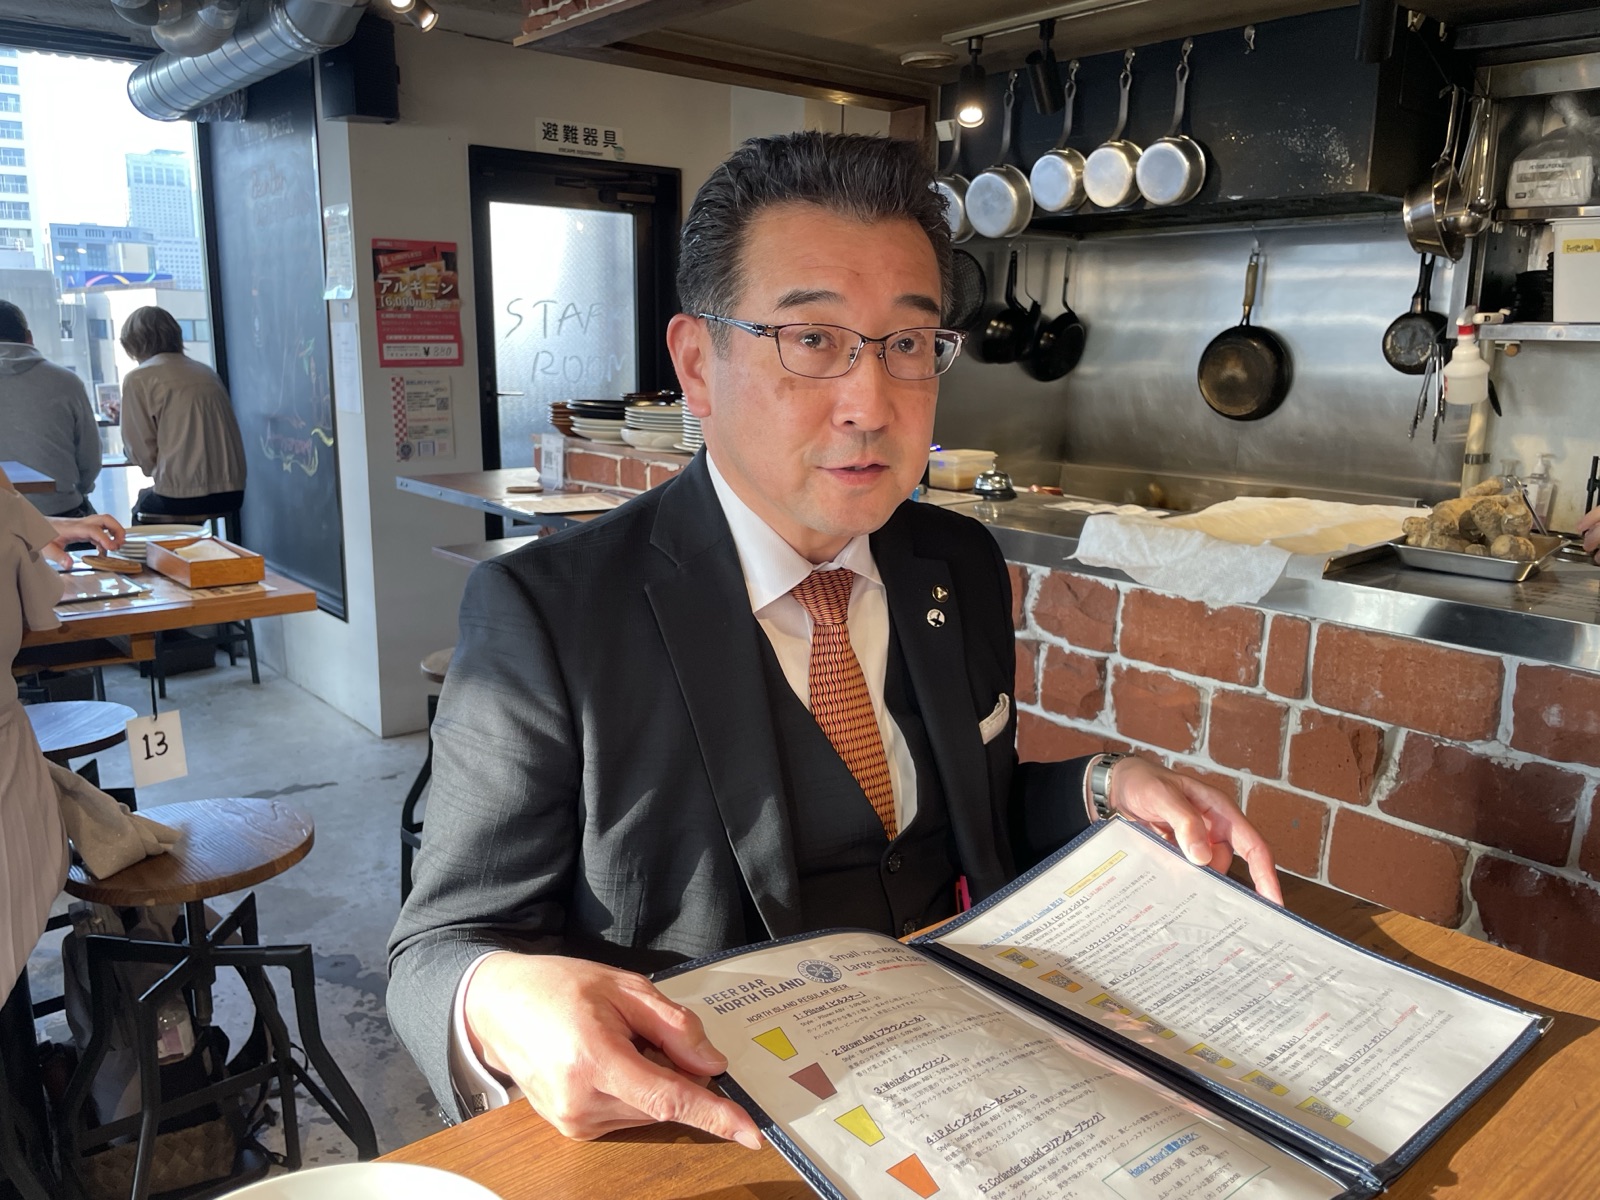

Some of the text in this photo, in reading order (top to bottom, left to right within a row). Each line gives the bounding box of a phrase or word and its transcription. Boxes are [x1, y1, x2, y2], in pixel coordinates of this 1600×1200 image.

[542, 122, 618, 149] 避難器具
[142, 731, 168, 760] 13
[1032, 905, 1053, 918] Limited
[1048, 896, 1066, 908] BEER
[828, 950, 861, 962] Small
[842, 961, 876, 972] Large
[702, 978, 766, 1005] BEER BAR
[712, 976, 806, 1015] NORTH ISLAND
[745, 983, 849, 1022] NORTH ISLAND REGULAR BEER
[859, 1032, 876, 1041] Ale
[951, 1130, 969, 1142] India
[965, 1123, 981, 1134] Pale
[976, 1117, 990, 1127] Ale
[1007, 1176, 1025, 1190] Spice
[1019, 1167, 1039, 1181] Black
[1034, 1163, 1048, 1172] Ale
[1125, 1159, 1152, 1178] Happy
